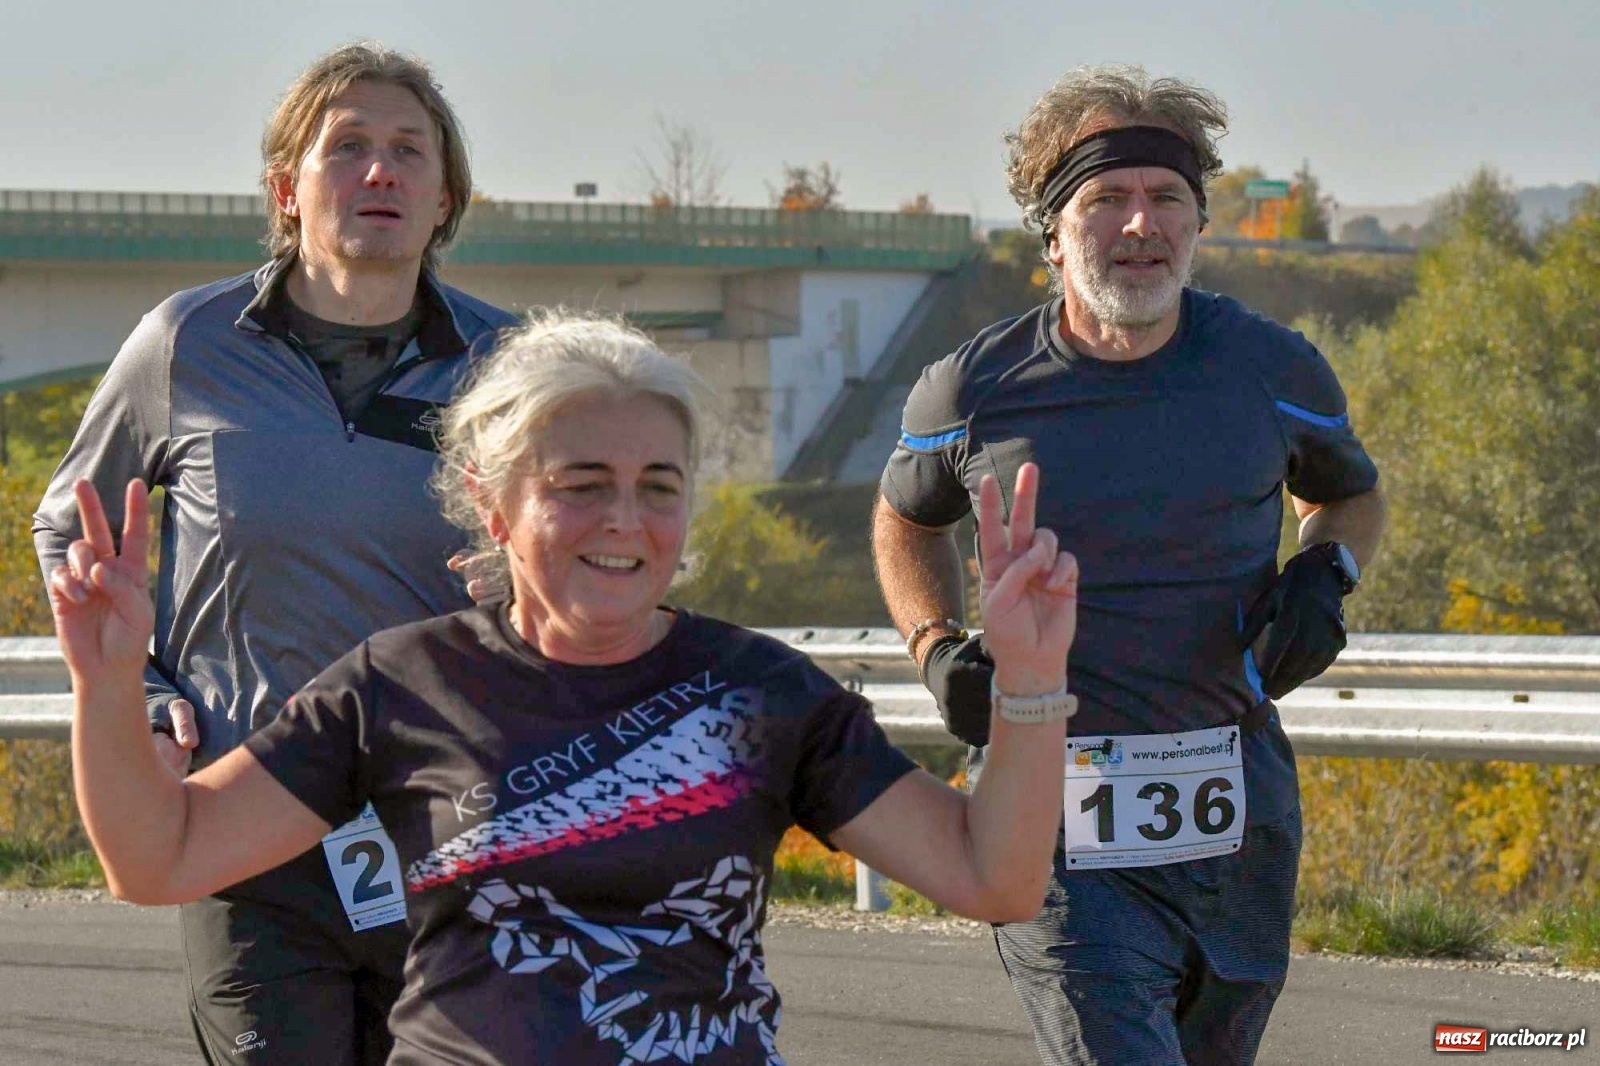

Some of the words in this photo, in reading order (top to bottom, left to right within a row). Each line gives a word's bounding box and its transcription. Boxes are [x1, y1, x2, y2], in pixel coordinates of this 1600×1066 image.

[451, 782, 497, 823] KS
[506, 734, 598, 794] GRYF
[605, 670, 727, 745] KIETRZ
[1131, 742, 1233, 761] www.personalbest.p
[1081, 777, 1236, 842] 136
[341, 840, 394, 904] 2
